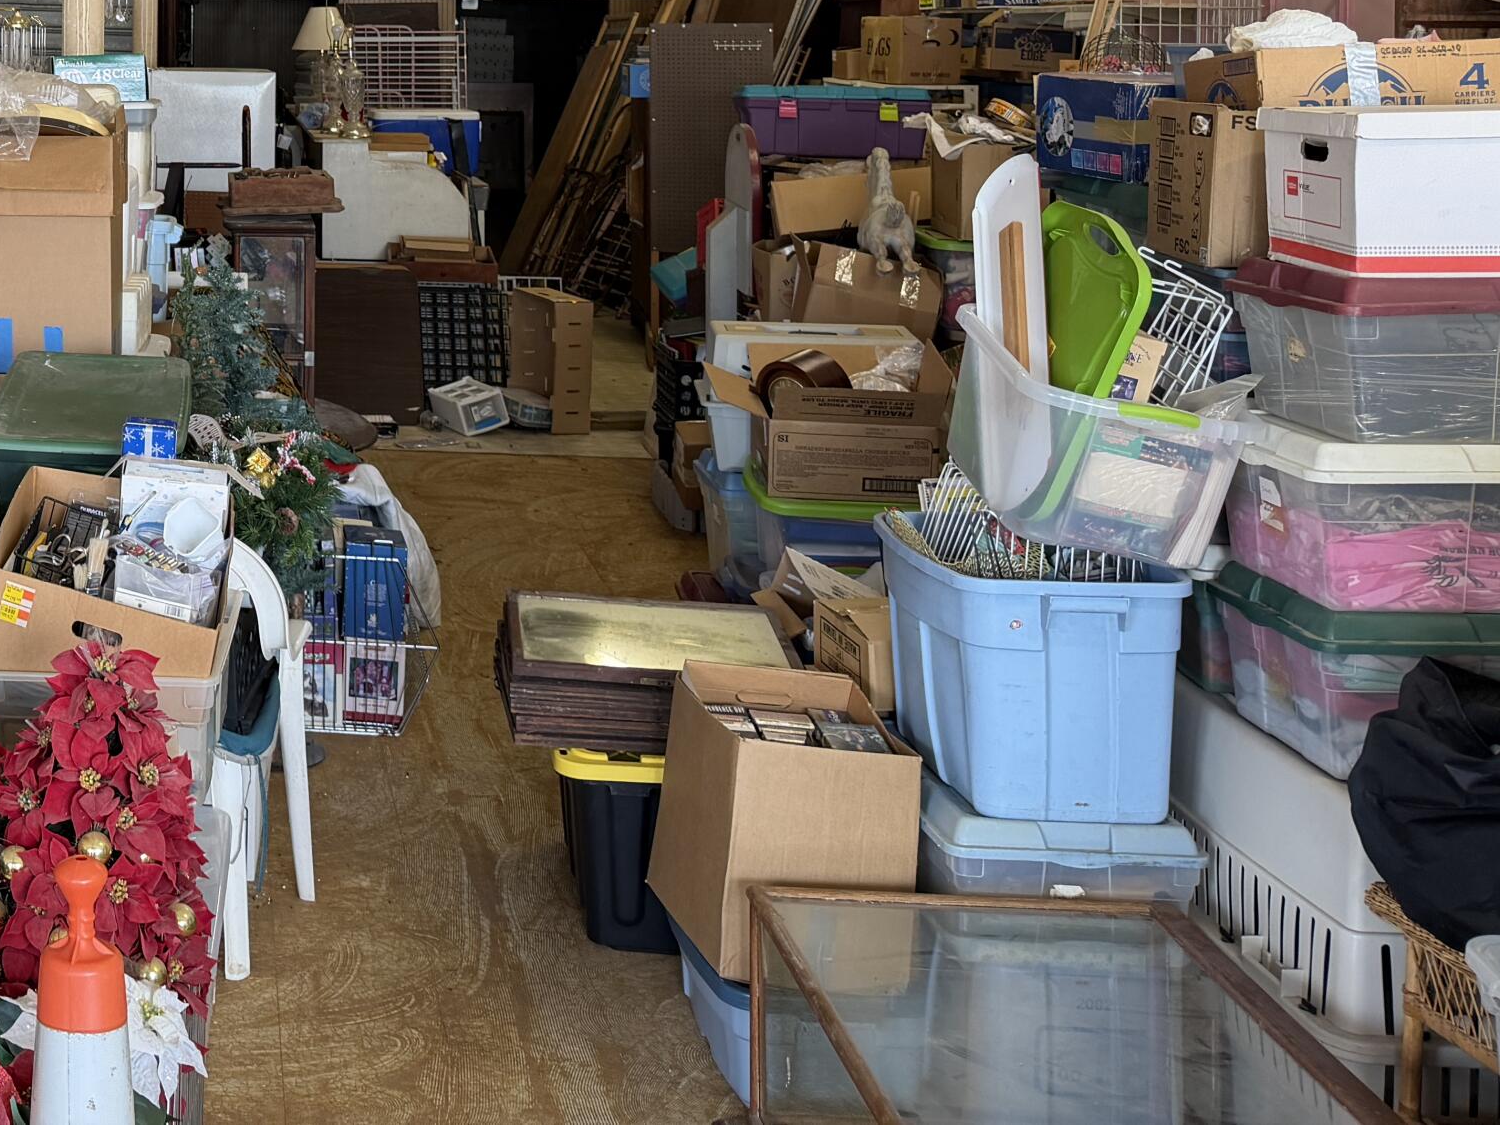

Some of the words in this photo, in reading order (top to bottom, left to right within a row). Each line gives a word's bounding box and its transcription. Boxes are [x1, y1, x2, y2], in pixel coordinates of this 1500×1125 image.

[867, 38, 891, 57] EGS
[1459, 62, 1490, 90] 4
[1454, 90, 1496, 98] CARRIERS
[1174, 236, 1190, 255] FSC
[863, 409, 914, 418] FRAGILE
[79, 505, 107, 517] DURACELL
